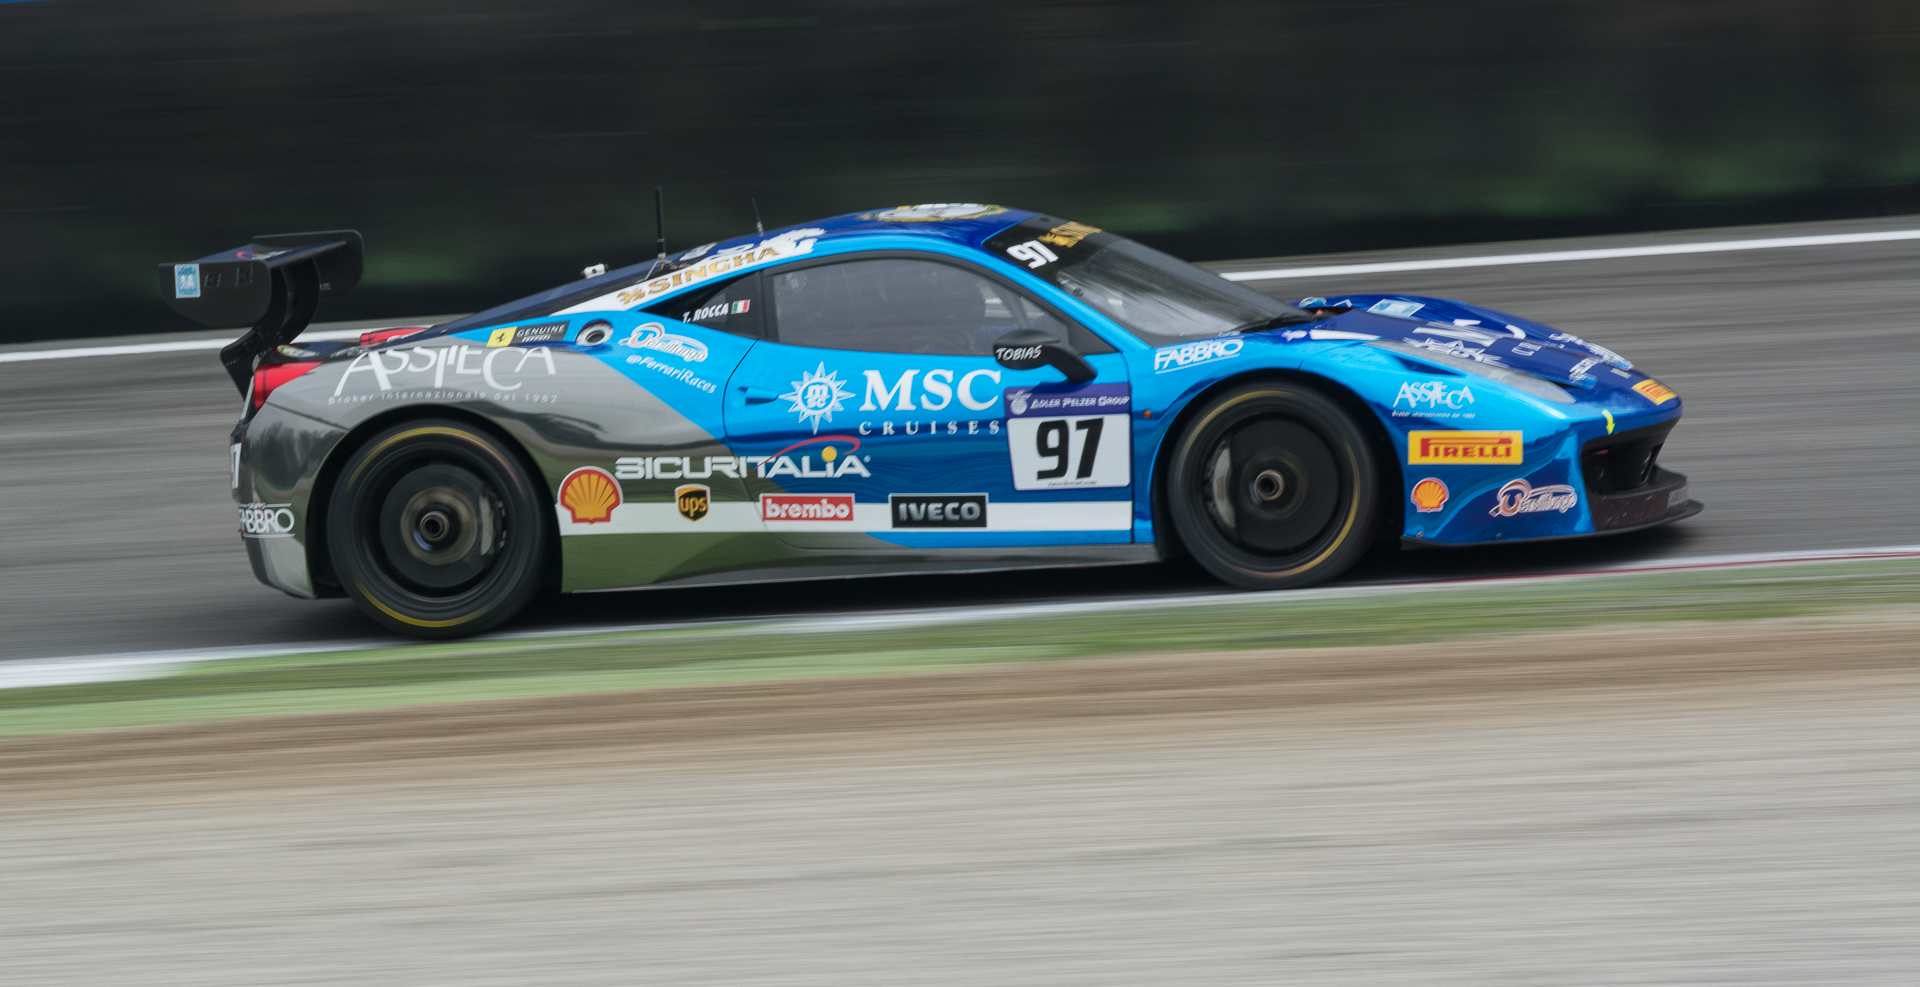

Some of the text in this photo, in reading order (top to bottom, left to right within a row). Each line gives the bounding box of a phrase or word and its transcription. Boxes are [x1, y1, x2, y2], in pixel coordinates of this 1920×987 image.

[1006, 239, 1059, 269] 97
[647, 247, 780, 295] SINGHA
[693, 302, 729, 322] ROCCA
[516, 324, 566, 337] GENUINE
[995, 344, 1043, 361] TOBIAS
[1153, 338, 1244, 370] FABBRO
[858, 369, 1002, 411] MSC
[858, 419, 1000, 436] CRUISES
[1036, 417, 1105, 480] 97
[1419, 437, 1514, 459] PIRELLI
[679, 494, 707, 514] ups
[765, 498, 850, 520] brembo
[898, 501, 981, 522] IVECO
